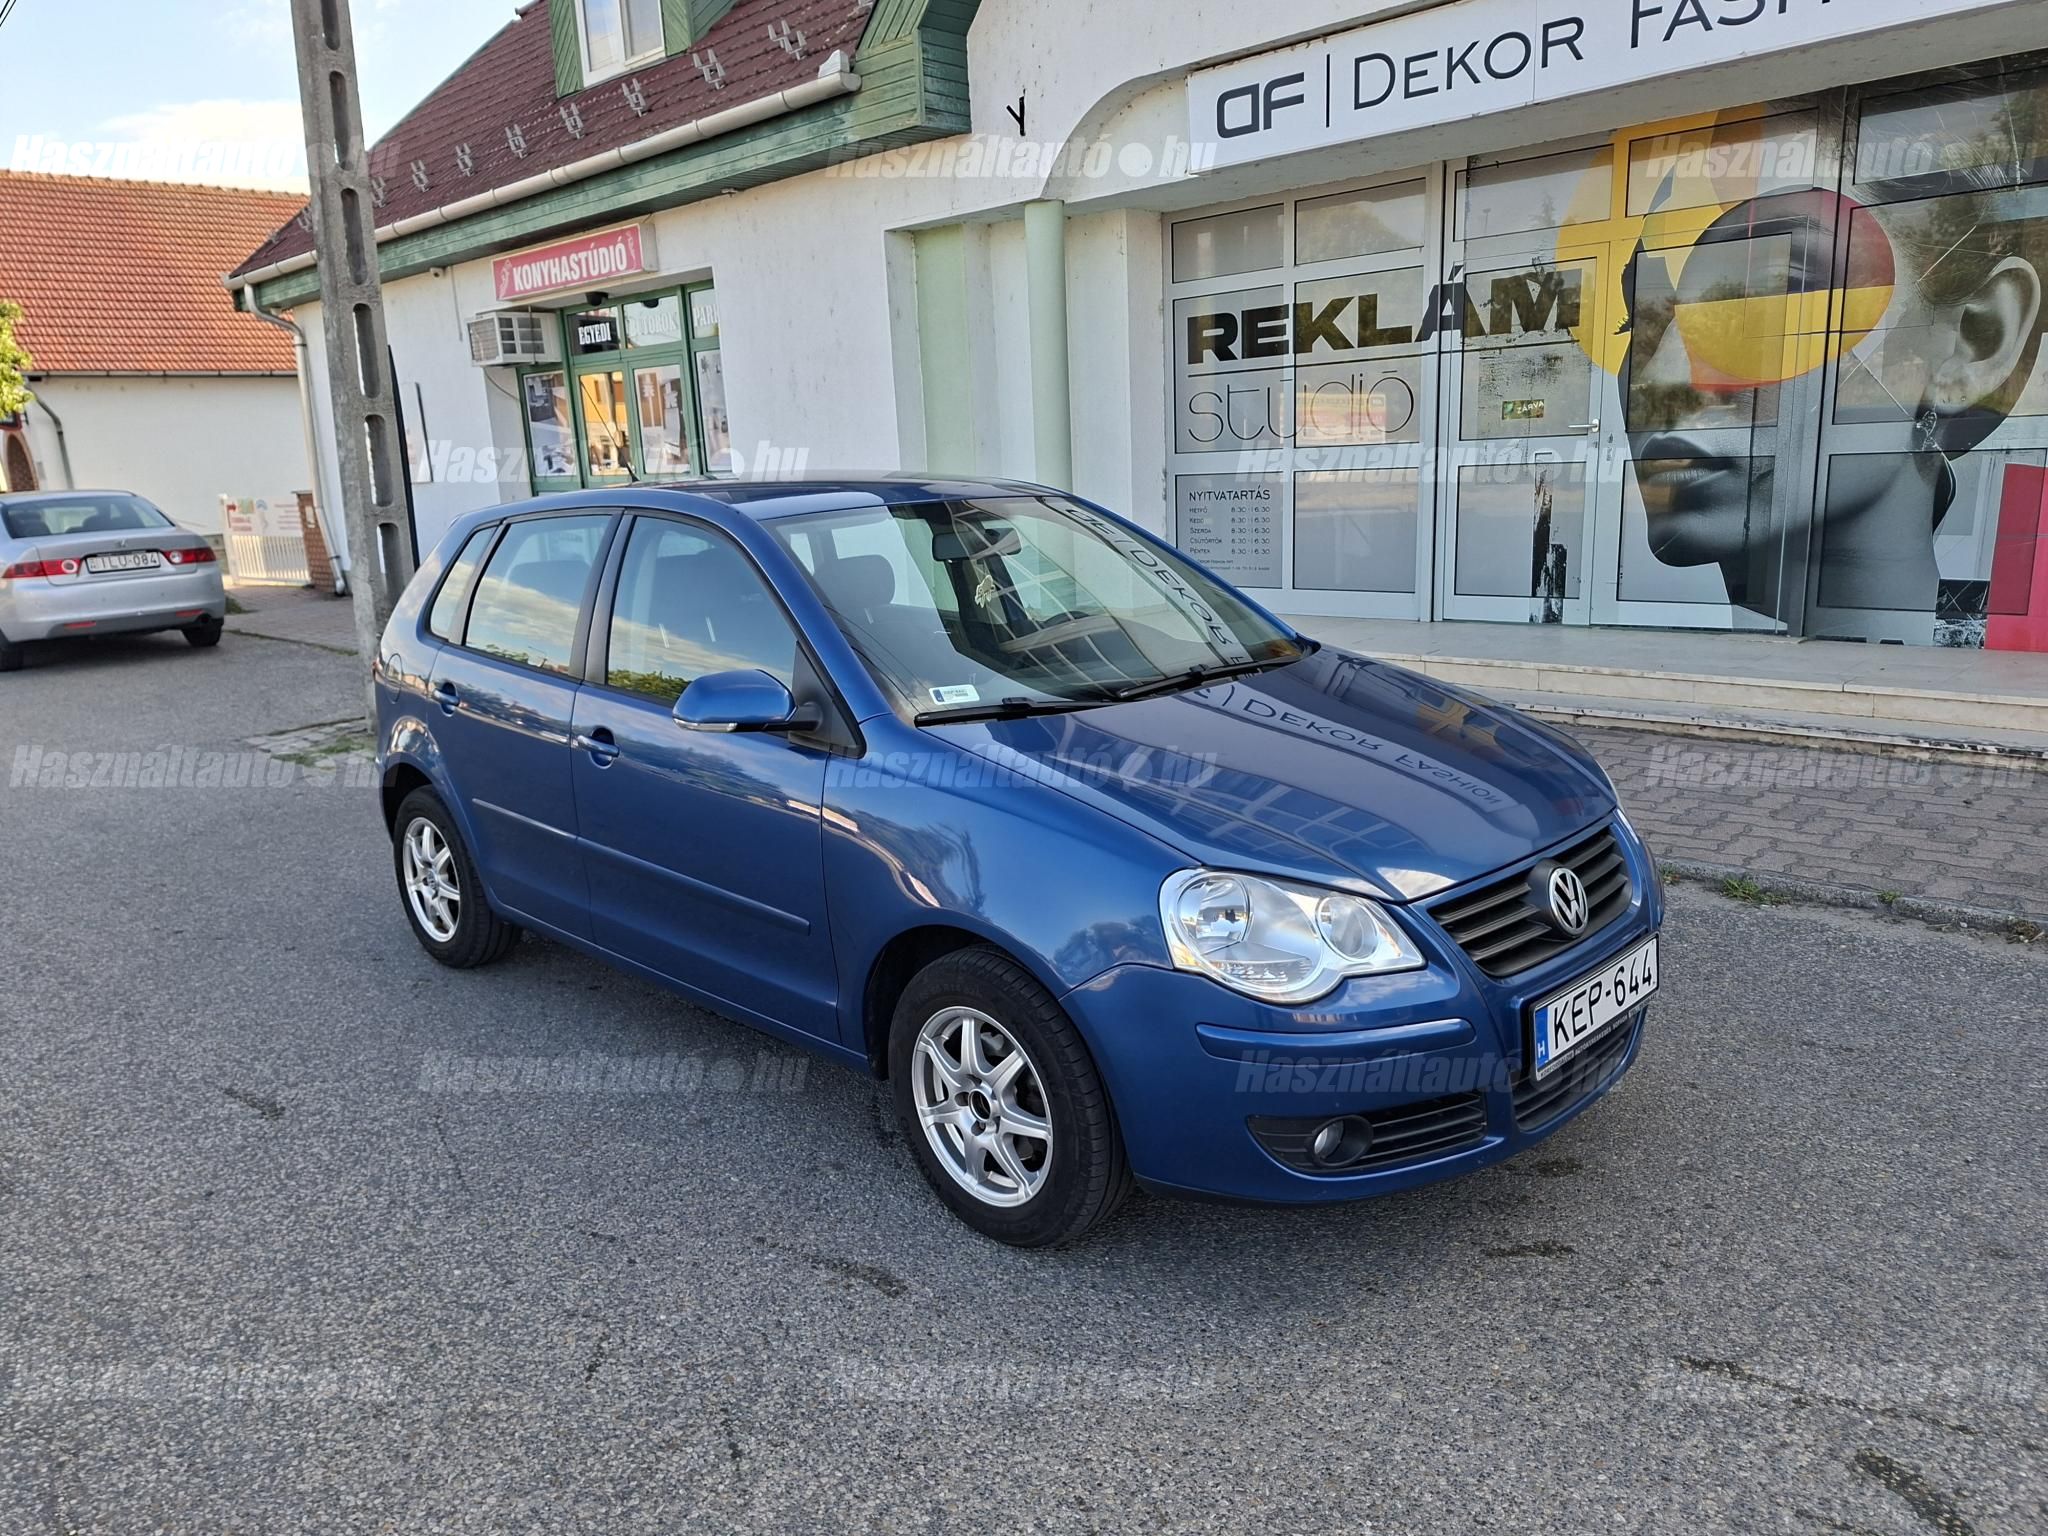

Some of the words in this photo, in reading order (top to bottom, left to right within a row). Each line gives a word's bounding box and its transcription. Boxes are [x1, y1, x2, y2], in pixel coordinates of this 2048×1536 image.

[1354, 16, 1584, 111] DEKOR
[512, 235, 628, 292] KONYHASTÚDIÓ
[578, 322, 612, 345] EGYEDI
[1187, 264, 1582, 365] REKLÁM
[1189, 485, 1271, 501] NYITVATARTÁS
[1554, 949, 1652, 1049] KEP-644
[1537, 1041, 1546, 1059] H
